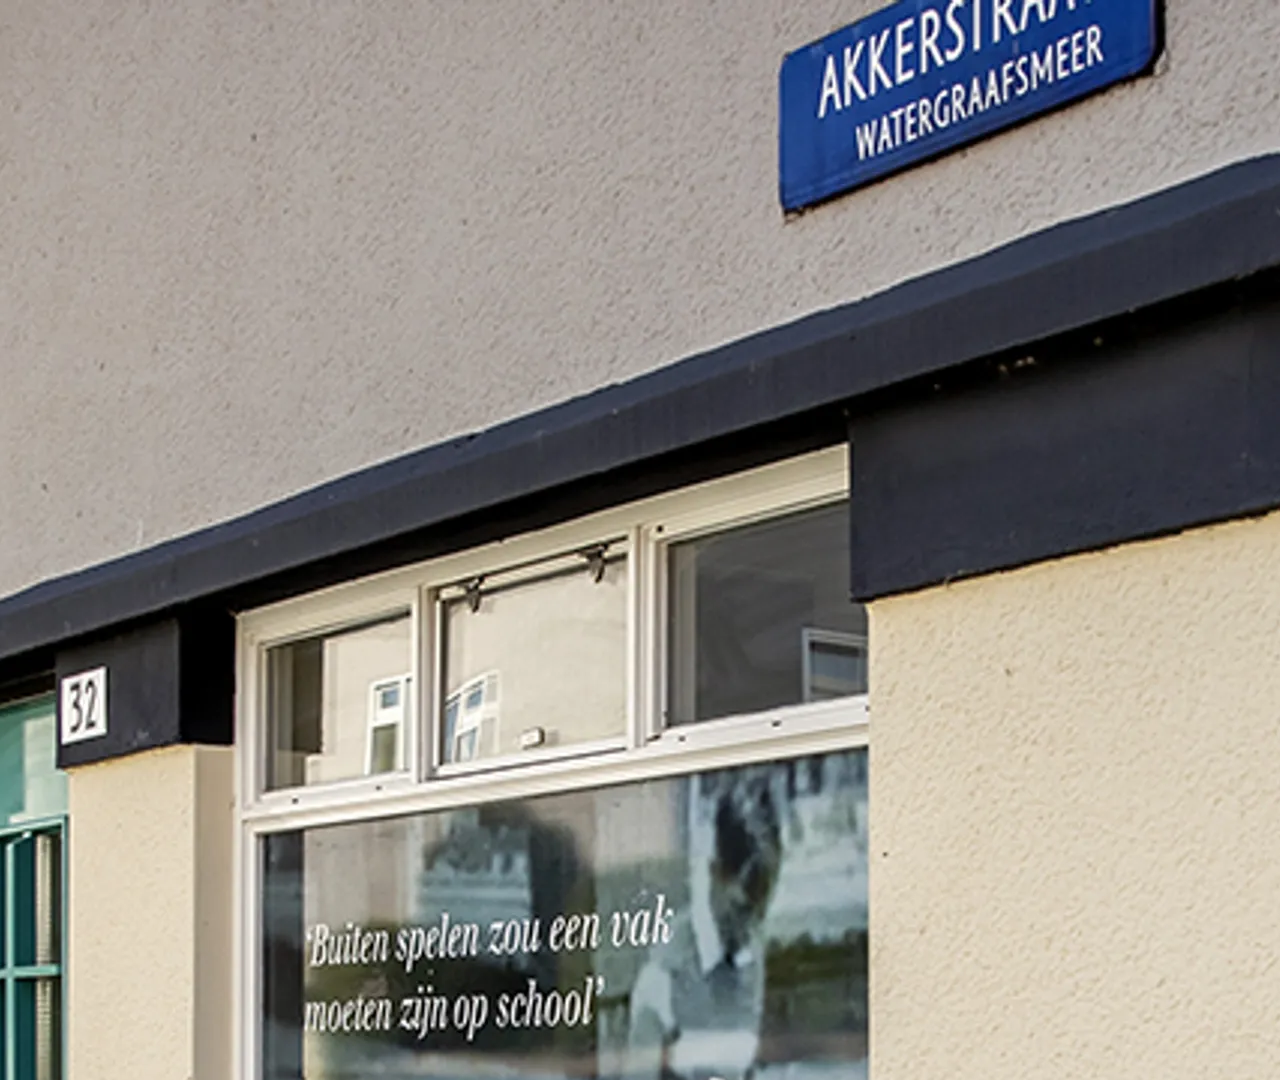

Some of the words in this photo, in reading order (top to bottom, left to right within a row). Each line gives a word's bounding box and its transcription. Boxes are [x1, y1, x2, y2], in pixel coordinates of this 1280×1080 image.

[818, 0, 1092, 118] AKKERSTRA
[856, 24, 1104, 161] WATERGRAAFSMEER
[69, 678, 98, 734] 32
[395, 911, 479, 974] spelen
[489, 919, 540, 955] zou
[550, 914, 603, 949] een
[610, 893, 674, 947] vak
[305, 991, 393, 1033] moeten
[399, 985, 449, 1041] zijn
[453, 993, 489, 1041] op
